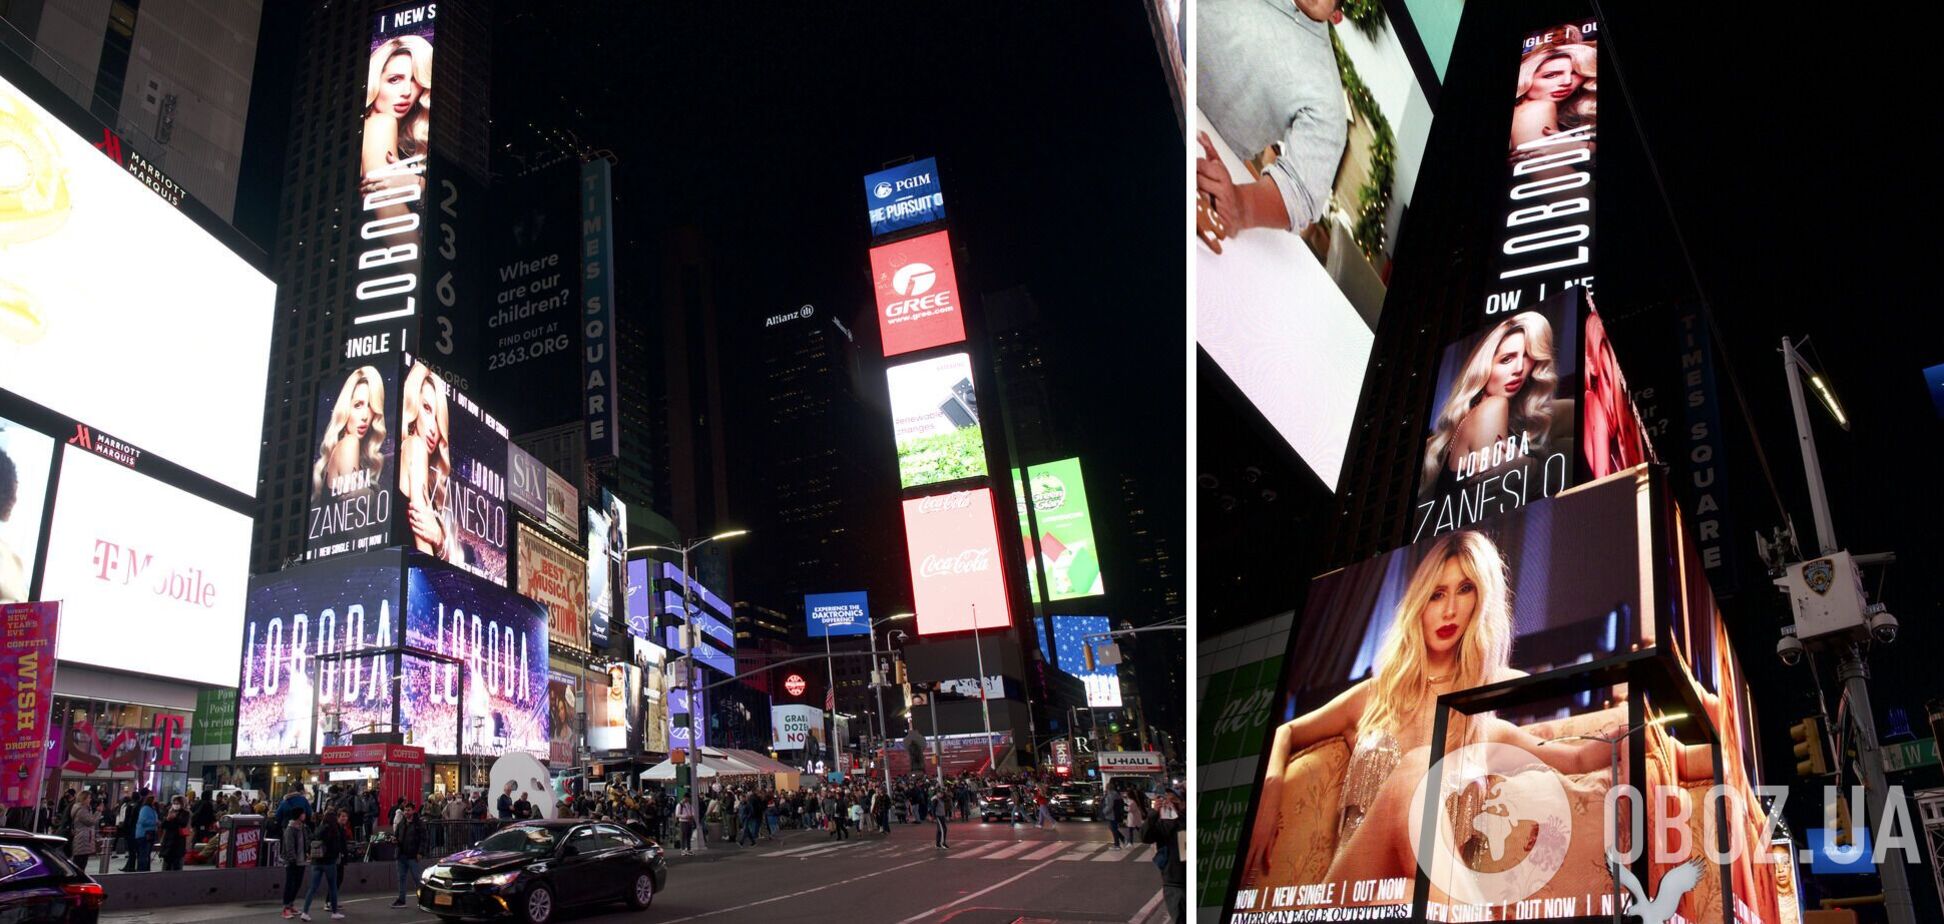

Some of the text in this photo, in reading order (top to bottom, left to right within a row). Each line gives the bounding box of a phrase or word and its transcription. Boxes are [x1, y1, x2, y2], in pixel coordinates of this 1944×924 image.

[395, 6, 425, 28] NEW
[1523, 33, 1553, 48] GLE
[129, 163, 180, 207] MARQUIS
[131, 152, 187, 200] MARRIOTT
[896, 173, 931, 192] PGIM
[886, 197, 932, 220] PURSUIT
[1500, 124, 1592, 280] LOBODA
[354, 153, 426, 325] LOBODA
[582, 174, 602, 281] TIMES
[499, 253, 559, 283] Where
[497, 273, 561, 304] are our
[488, 288, 569, 328] children?
[886, 290, 950, 318] GREE
[888, 305, 954, 325] www.gree.com
[765, 311, 799, 328] Allianz
[345, 333, 390, 358] INGLE
[498, 321, 560, 348] FIND OUT AT
[488, 334, 569, 371] 2363.ORG
[1680, 314, 1705, 408] TIMES
[585, 295, 610, 440] SQUARE
[95, 444, 136, 466] MARQUIS
[97, 434, 141, 459] MARRIOTT
[471, 458, 505, 502] LOBODA
[430, 466, 505, 548] ZANESLO
[1413, 454, 1566, 544] ZANESLO
[1690, 421, 1723, 570] SQUARE
[308, 489, 389, 540] ZANESLO
[541, 559, 565, 583] BEST
[533, 570, 570, 603] MUSICAL
[812, 609, 864, 619] DAKTRONICS
[7, 639, 48, 648] CONFETTI
[8, 629, 25, 637] EVE
[243, 598, 391, 705] LOBODA
[430, 601, 530, 705] LOBODA
[16, 651, 39, 731] WISH
[324, 751, 352, 759] COFFEED
[393, 749, 420, 759] COFFEED
[1107, 757, 1153, 765] U-HAUL
[236, 828, 260, 846] JERSEY
[237, 847, 257, 864] BOYS
[1236, 878, 1407, 910] NOW NEW SINGLE OUT NOW
[1231, 903, 1409, 924] AMERICAN EAGLE OUTFITTERS
[1426, 901, 1448, 923] NEW
[1449, 902, 1494, 922] SINGLE
[1516, 900, 1543, 920] OUT
[1545, 897, 1577, 918] NOW
